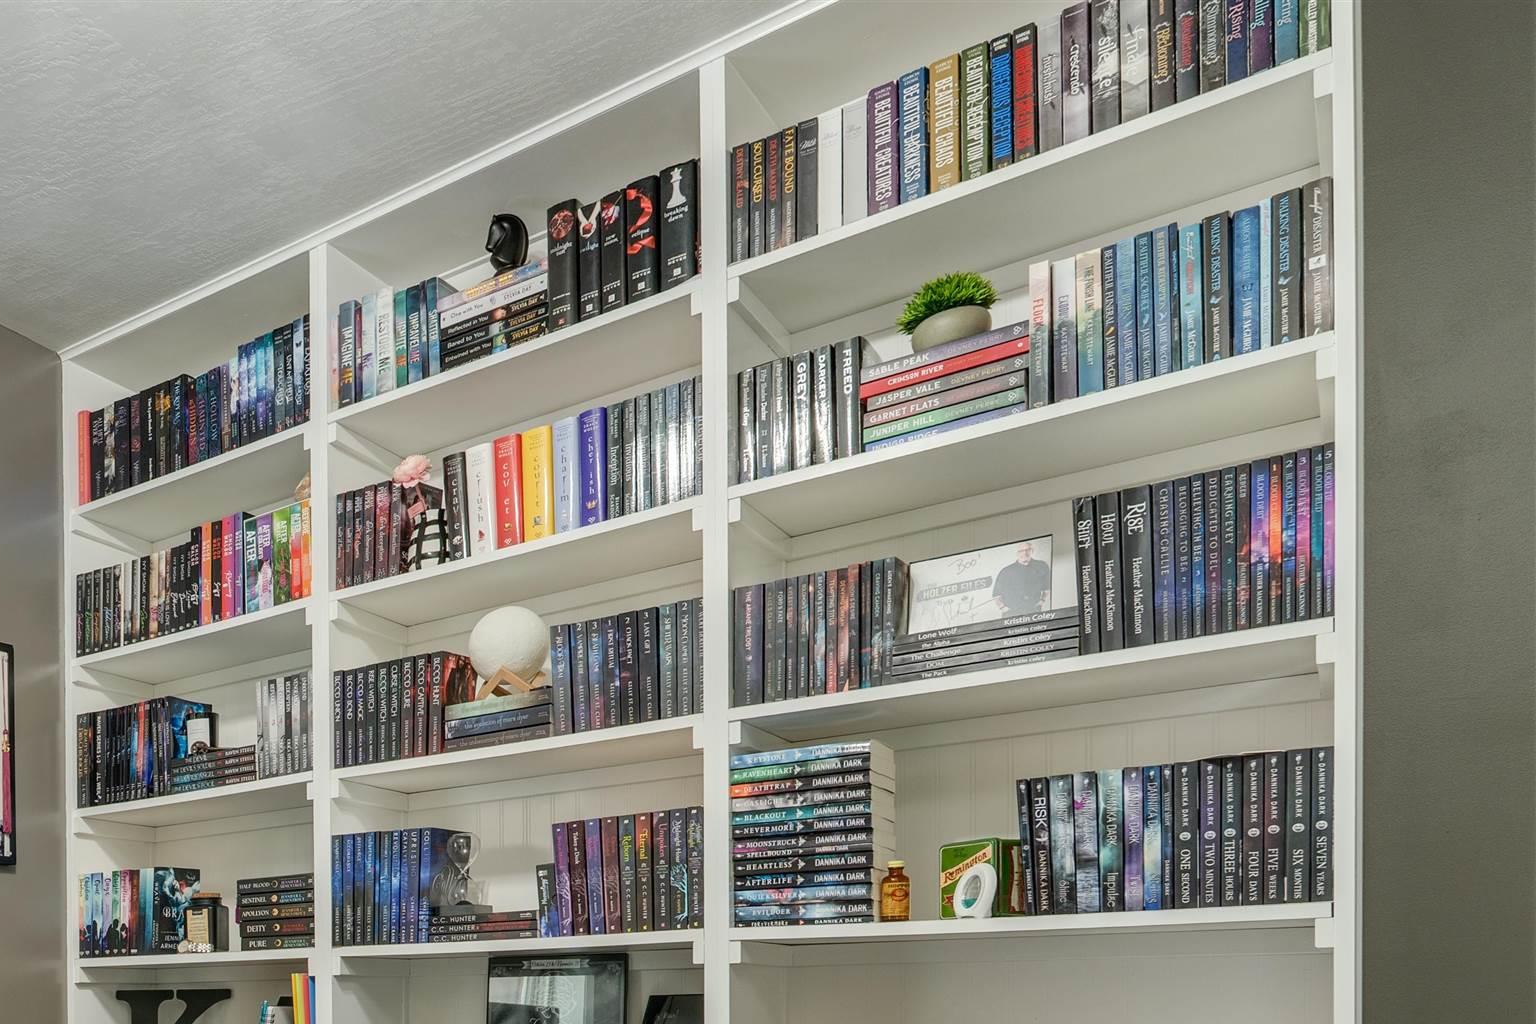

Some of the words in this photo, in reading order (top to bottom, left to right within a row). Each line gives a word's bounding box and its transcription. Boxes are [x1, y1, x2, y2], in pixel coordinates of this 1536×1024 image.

[1227, 3, 1244, 42] Rising
[966, 55, 983, 110] BEAUTIFUL
[1069, 44, 1080, 95] crescendo
[903, 83, 920, 137] BEAUTIFUL
[935, 76, 953, 134] BEAUTIFUL
[875, 98, 891, 149] BEAUTIFUL
[967, 104, 984, 162] REDEMPTION
[904, 134, 921, 184] DARKNESS
[936, 131, 954, 168] CHAOS
[875, 148, 892, 201] CREATURES
[664, 205, 689, 218] breaking
[631, 227, 650, 240] eclipse
[1211, 217, 1221, 254] WALKING
[1211, 255, 1221, 293] DISASTER
[503, 291, 521, 301] SYLVIA
[521, 285, 533, 294] DAY
[428, 309, 438, 340] SHATTER
[1032, 298, 1044, 329] FLOCK
[341, 324, 353, 368] IMAGINE
[341, 368, 353, 385] ME
[818, 354, 826, 399] DARKER
[843, 348, 852, 394] FREED
[868, 362, 900, 377] SABLE
[903, 353, 930, 367] PEAK
[887, 372, 919, 386] CRIMSON
[921, 364, 944, 377] RIVER
[796, 362, 807, 400] GREY
[876, 390, 912, 406] JASPER
[915, 381, 941, 395] VALE
[869, 407, 906, 424] GARNET
[910, 398, 940, 412] FLATS
[869, 422, 909, 438] JUNIPER
[912, 415, 936, 427] HILL
[608, 445, 617, 485] Inception
[1159, 488, 1169, 536] CHASING
[1178, 486, 1187, 538] BELONGING
[1209, 477, 1217, 533] DEDICATED
[262, 524, 270, 547] AFTER
[280, 520, 288, 544] AFTER
[1101, 513, 1116, 546] HOWL
[246, 530, 256, 562] AFTER
[1179, 540, 1187, 553] TO
[1210, 537, 1218, 549] TO
[1160, 539, 1170, 575] CALLIE
[1180, 556, 1188, 572] BEA
[1210, 553, 1218, 570] DEL
[1082, 565, 1090, 592] Heather
[1105, 560, 1114, 588] Heather
[1132, 557, 1143, 588] Heather
[1004, 615, 1031, 626] Kristin
[1032, 612, 1056, 622] Coley
[1084, 593, 1092, 634] MacKinnon
[1106, 590, 1115, 631] MacKinnon
[1134, 590, 1144, 635] MacKinnon
[918, 630, 937, 640] Lone
[939, 628, 957, 636] Wolf
[911, 653, 924, 661] The
[926, 648, 961, 660] Challenge
[922, 671, 932, 679] The
[432, 685, 440, 705] HUNT
[811, 762, 842, 772] DANNIKA
[844, 758, 863, 768] DARK
[744, 783, 791, 792] DEATHTRAP
[812, 777, 842, 787] DANNIKA
[844, 774, 864, 782] DARK
[1318, 763, 1326, 794] DANNIKA
[744, 812, 786, 822] BLACKOUT
[814, 806, 844, 816] DANNIKA
[846, 804, 864, 812] DARK
[1034, 797, 1048, 829] RISK
[1318, 796, 1326, 815] DARK
[744, 824, 794, 834] NEVERMORE
[816, 834, 846, 844] DANNIKA
[848, 832, 867, 841] DARK
[621, 834, 632, 862] Reborn
[639, 828, 648, 860] Eternal
[746, 838, 797, 848] MOONSTRUCK
[746, 849, 792, 858] SPELLBOUND
[1204, 843, 1215, 866] TWO
[1316, 836, 1327, 869] SEVEN
[746, 862, 793, 871] HEARTLESS
[1038, 851, 1048, 886] DANNIKA
[1180, 849, 1191, 870] ONE
[1224, 840, 1235, 873] THREE
[1248, 851, 1259, 878] FOUR
[1267, 848, 1279, 871] FIVE
[1293, 849, 1304, 866] SIX
[745, 877, 793, 886] AFTERLIFE
[1104, 872, 1119, 908] Impulse
[1181, 872, 1190, 904] SECOND
[1205, 869, 1215, 903] MINUTES
[1225, 876, 1235, 901] HOURS
[1248, 881, 1259, 901] DAYS
[1268, 874, 1278, 899] WEEKS
[1293, 868, 1303, 899] MONTHS
[1317, 871, 1327, 896] YEARS
[241, 896, 267, 904] SENTINEL
[1040, 889, 1048, 911] DARK
[246, 924, 266, 933] DEITY
[248, 940, 267, 948] PURE
